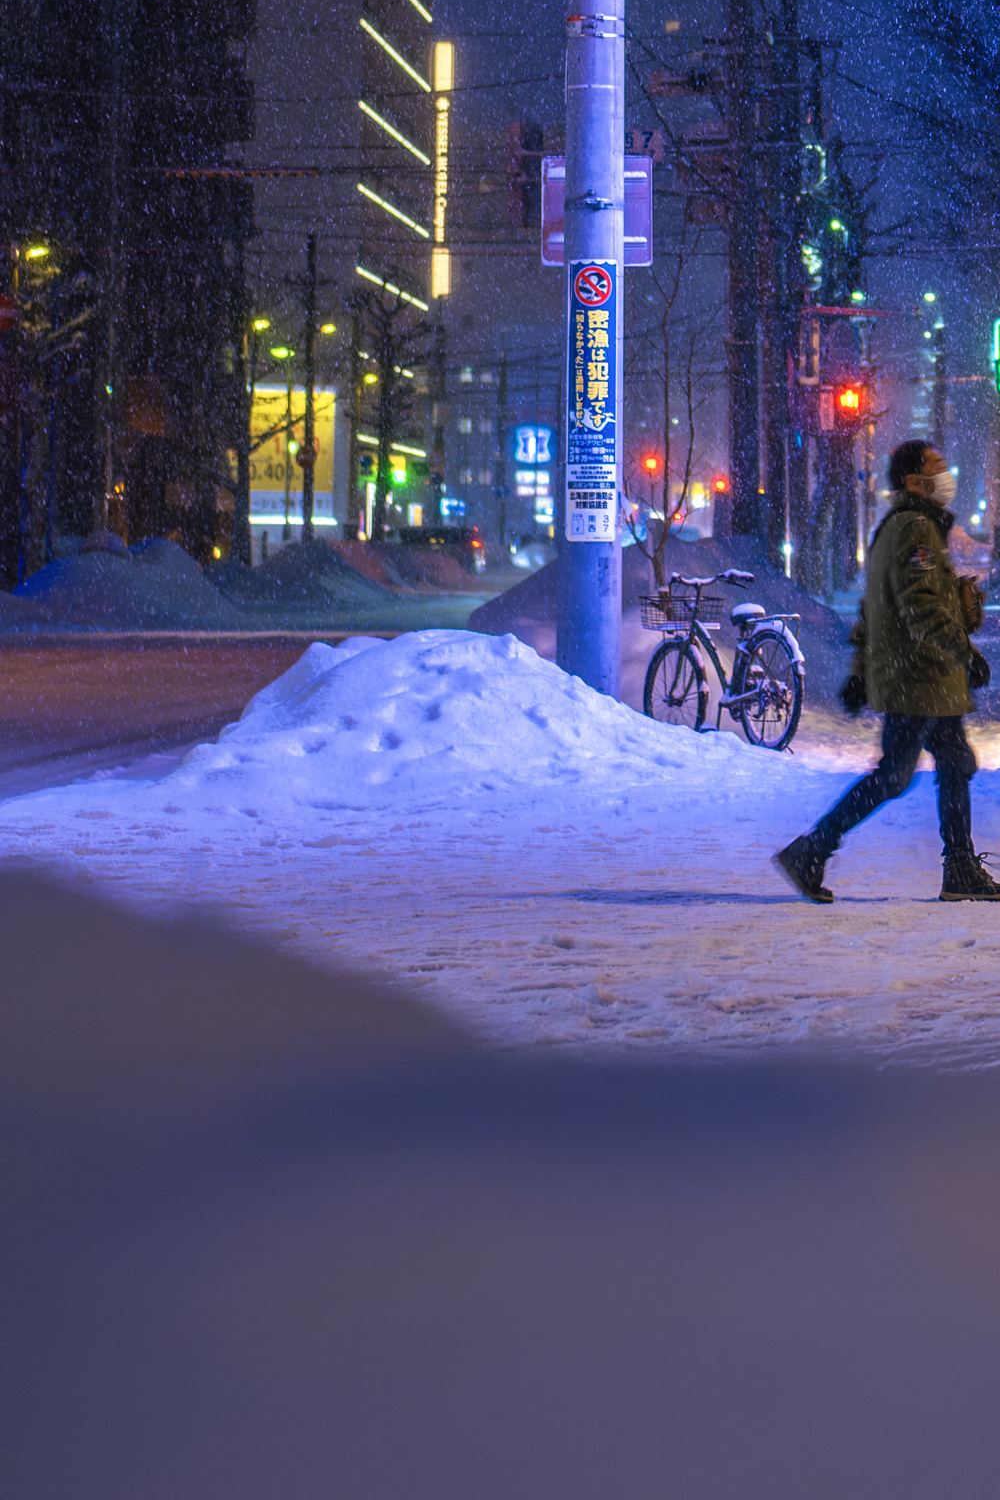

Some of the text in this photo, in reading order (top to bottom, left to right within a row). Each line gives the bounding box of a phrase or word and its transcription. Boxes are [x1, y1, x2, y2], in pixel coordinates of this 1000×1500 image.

[436, 111, 449, 155] VESSEL
[435, 156, 448, 196] HOTEL
[587, 309, 609, 427] 密漁は犯罪です
[569, 491, 613, 500] 北海道密漁防止
[588, 524, 596, 532] 西
